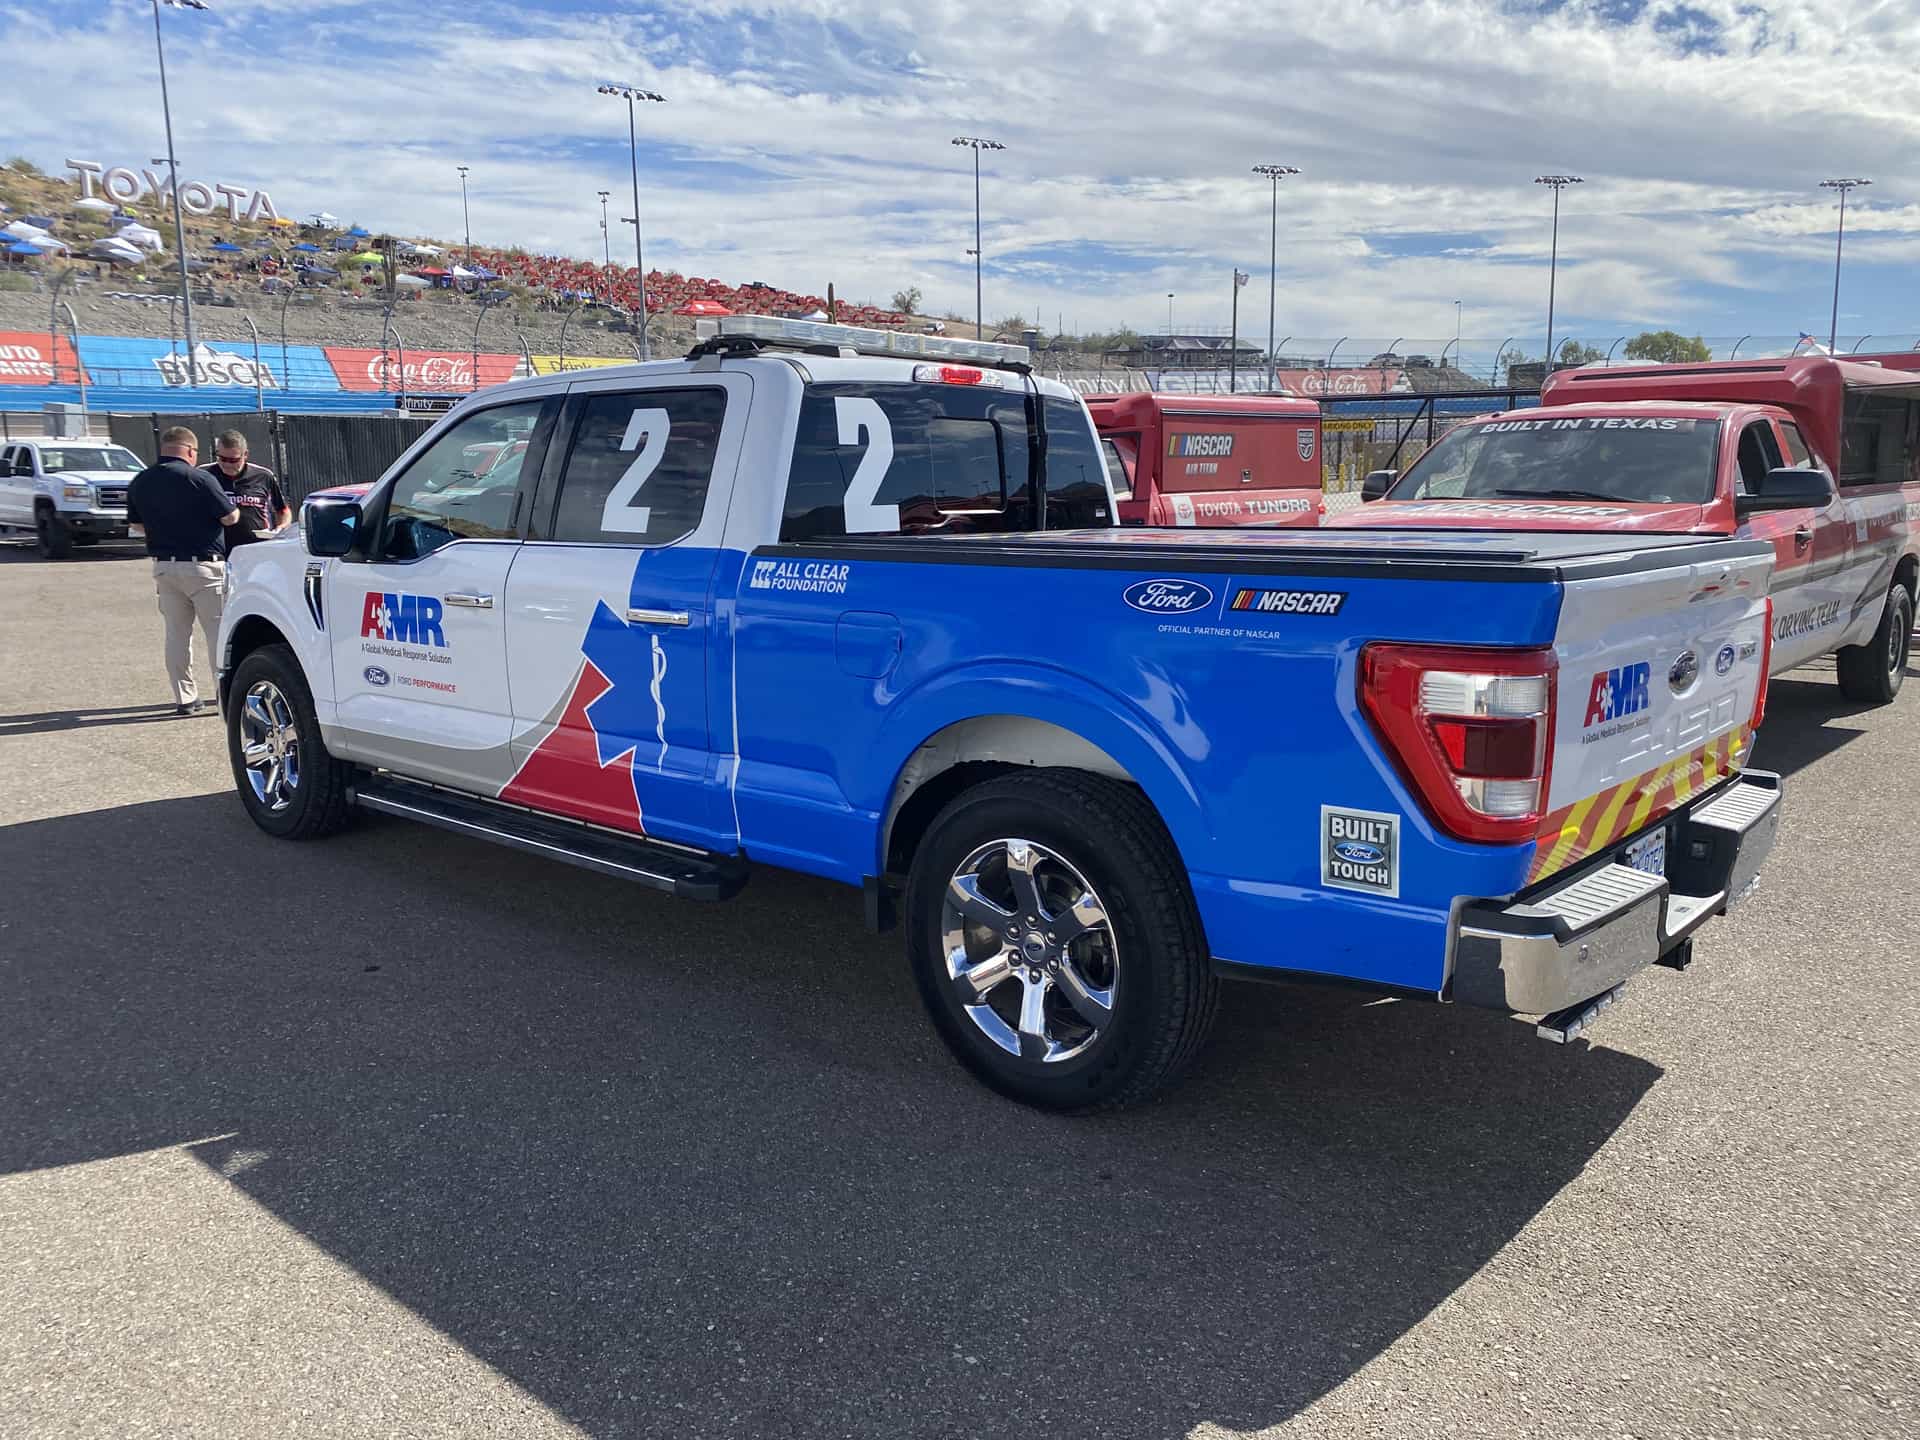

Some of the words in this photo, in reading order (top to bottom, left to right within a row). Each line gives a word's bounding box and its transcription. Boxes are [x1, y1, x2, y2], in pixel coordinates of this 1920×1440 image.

[65, 158, 279, 224] TOYOTA
[0, 345, 41, 360] UTO
[0, 361, 54, 376] ARTS
[156, 360, 277, 387] BUSCH
[1480, 420, 1549, 434] BUILT
[1552, 419, 1583, 430] IN
[1588, 418, 1679, 430] TEXAS
[1184, 435, 1233, 456] NASCAR
[601, 408, 671, 534] 2
[834, 396, 900, 534] 2
[1197, 502, 1241, 516] TOYOTA
[1245, 499, 1311, 514] TUNDRA
[775, 562, 800, 578] ALL
[804, 563, 850, 580] CLEAR
[771, 578, 847, 594] FOUNDATION
[1138, 583, 1197, 609] Ford
[1257, 591, 1342, 614] NASCAR
[361, 592, 446, 648] AMR
[1778, 608, 1817, 640] DRYING
[1816, 600, 1840, 627] TEAM
[1158, 625, 1192, 634] OFFICIAL
[1194, 627, 1231, 637] PARTNER
[1232, 629, 1245, 637] OF
[1246, 630, 1281, 640] NASCAR
[381, 645, 401, 657] Medical
[402, 647, 427, 662] Response
[412, 678, 456, 693] PERFORMANCE
[1584, 661, 1650, 728] AMR
[1331, 816, 1389, 844] BUILT
[1344, 845, 1373, 859] Ford
[1331, 861, 1388, 885] TOUGH
